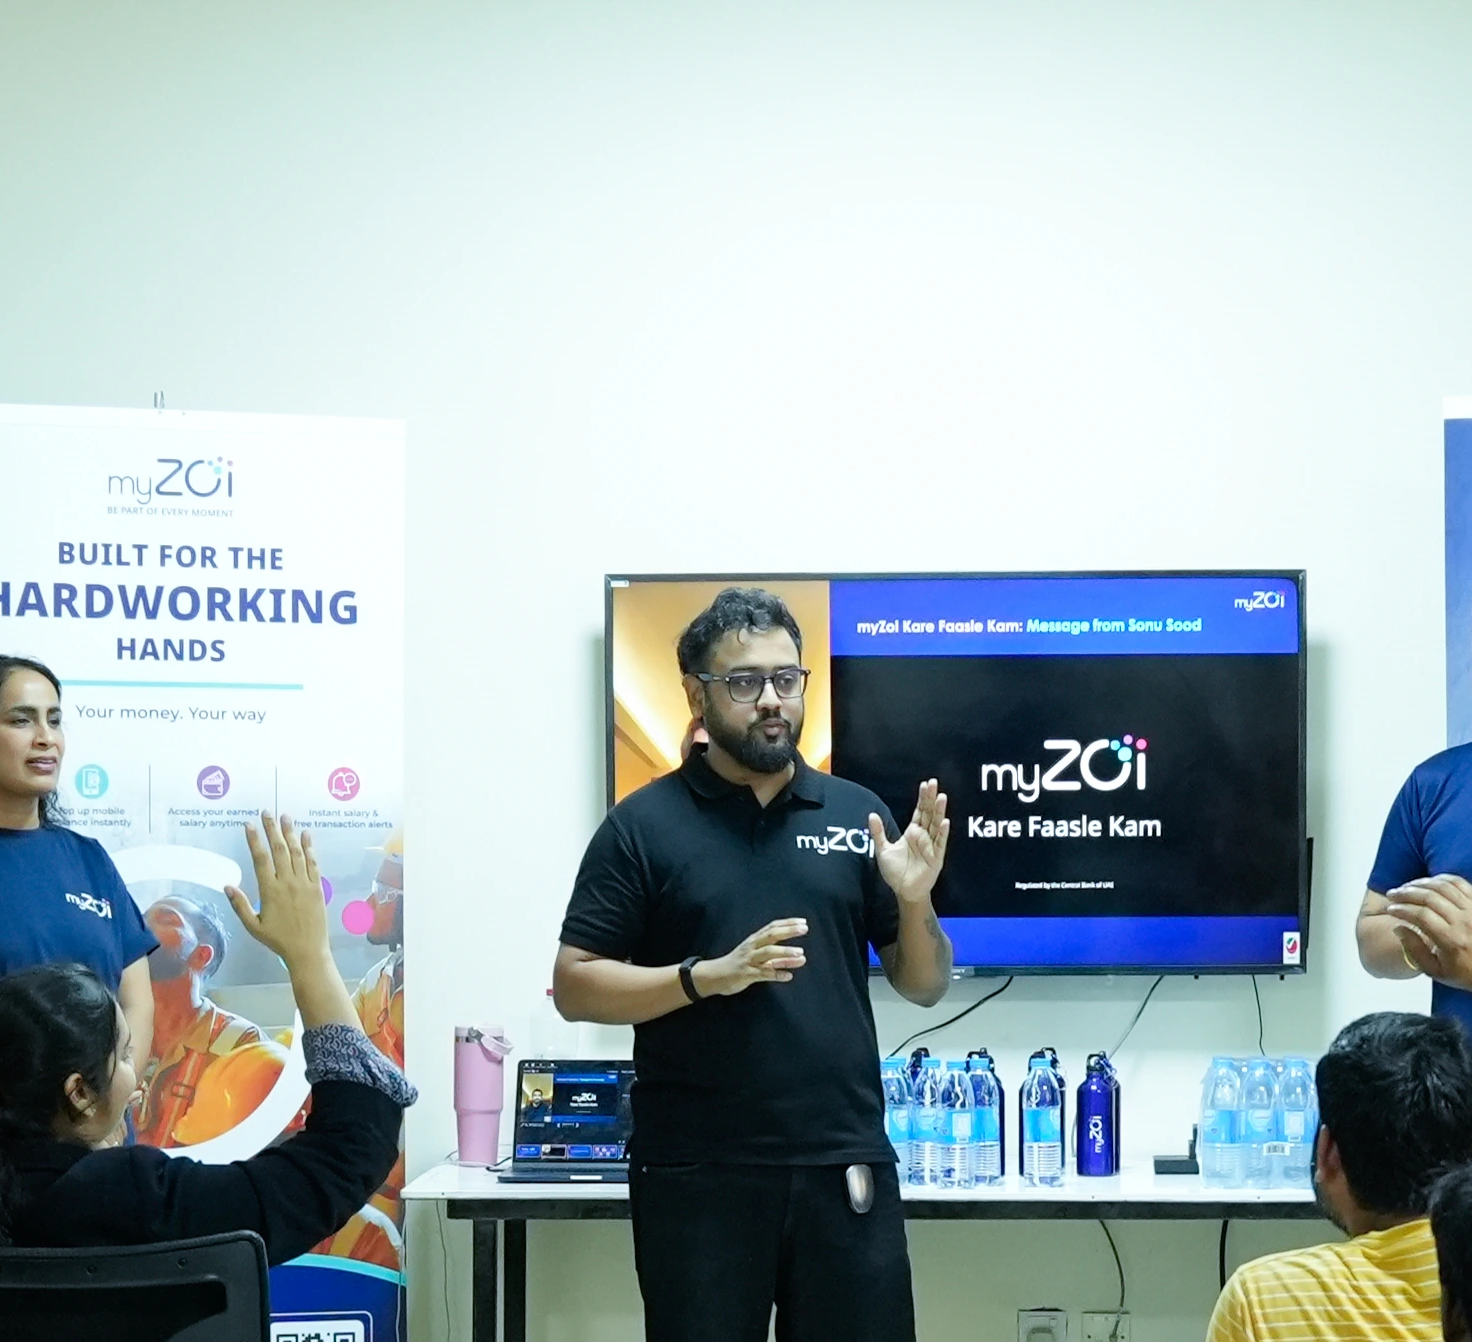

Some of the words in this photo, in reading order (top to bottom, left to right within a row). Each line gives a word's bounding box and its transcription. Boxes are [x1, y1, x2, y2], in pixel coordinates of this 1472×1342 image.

[107, 506, 118, 515] BE
[121, 506, 144, 515] PART
[146, 507, 159, 516] OF
[161, 507, 189, 516] EVERY
[191, 508, 234, 518] MOMENT
[58, 541, 150, 568] BUILT
[159, 545, 219, 569] FOR
[228, 547, 284, 571] THE
[902, 619, 935, 634] Kare
[938, 618, 984, 634] Faasle
[986, 619, 1024, 633] Kam:
[1026, 618, 1090, 636] Message
[1092, 617, 1126, 633] from
[1128, 618, 1163, 633] Sonu
[1165, 617, 1203, 632] Sood
[116, 637, 226, 663] HANDS
[75, 704, 115, 719] Your
[120, 707, 184, 723] money.
[188, 706, 228, 720] Your
[232, 710, 267, 724] way
[77, 808, 90, 817] up
[92, 806, 126, 816] mobile
[167, 807, 201, 816] Access
[202, 808, 224, 818] your
[226, 807, 260, 816] earned
[308, 808, 341, 818] Instant
[343, 809, 371, 819] salary
[372, 809, 379, 818] &
[90, 818, 132, 828] instantly
[179, 819, 207, 828] salary
[293, 819, 312, 828] free
[314, 819, 366, 829] transaction
[368, 819, 393, 829] alerts
[968, 815, 1022, 838] Kare
[1028, 814, 1103, 838] Faasle
[1109, 815, 1162, 838] Kam
